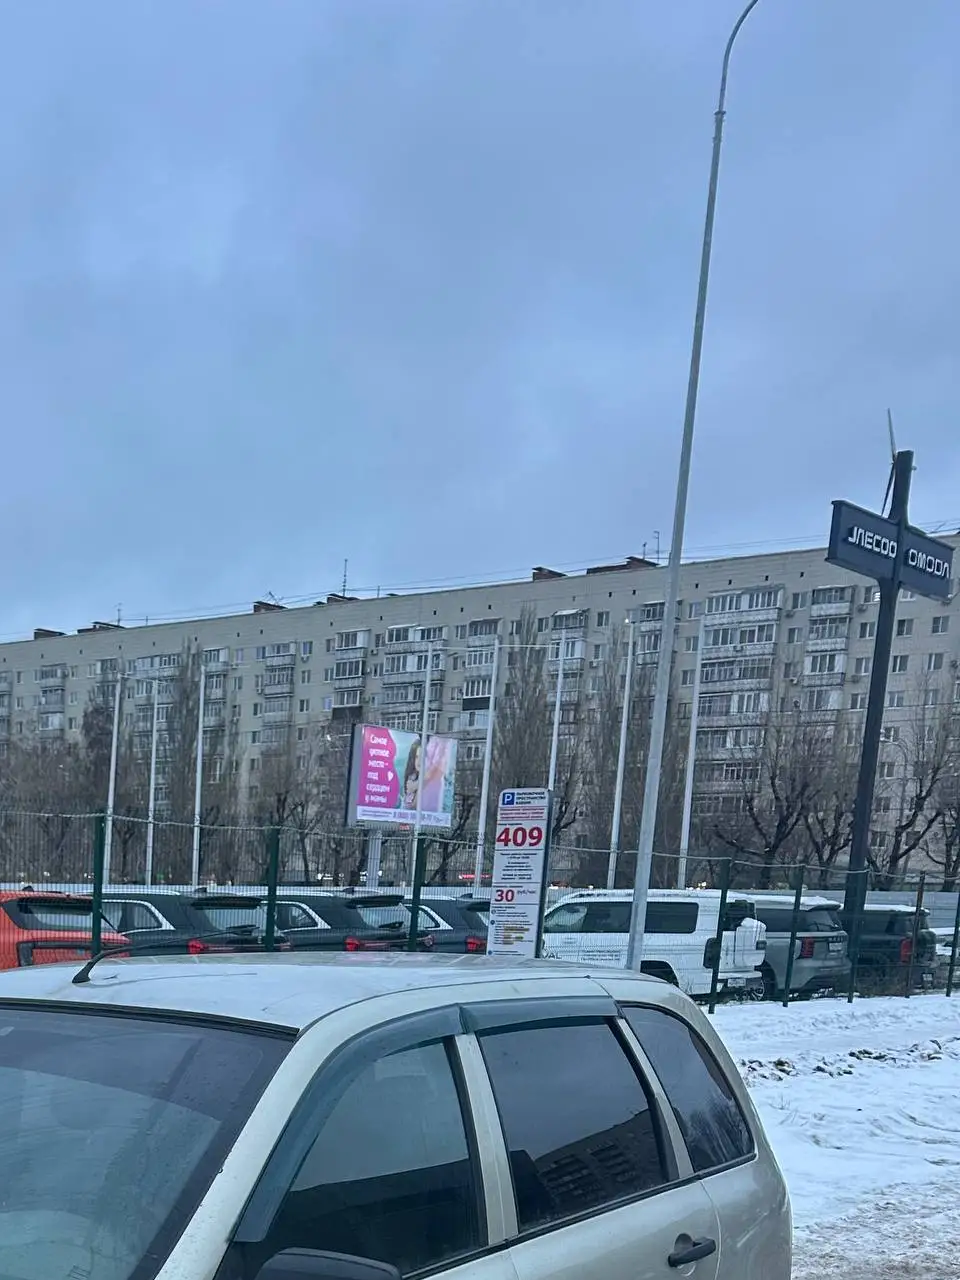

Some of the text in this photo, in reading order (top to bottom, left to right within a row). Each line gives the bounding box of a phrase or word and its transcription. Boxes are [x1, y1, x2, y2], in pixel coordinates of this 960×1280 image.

[848, 526, 898, 559] JAECOO
[908, 548, 950, 579] OMODA
[496, 826, 543, 847] 409
[494, 889, 515, 902] 30
